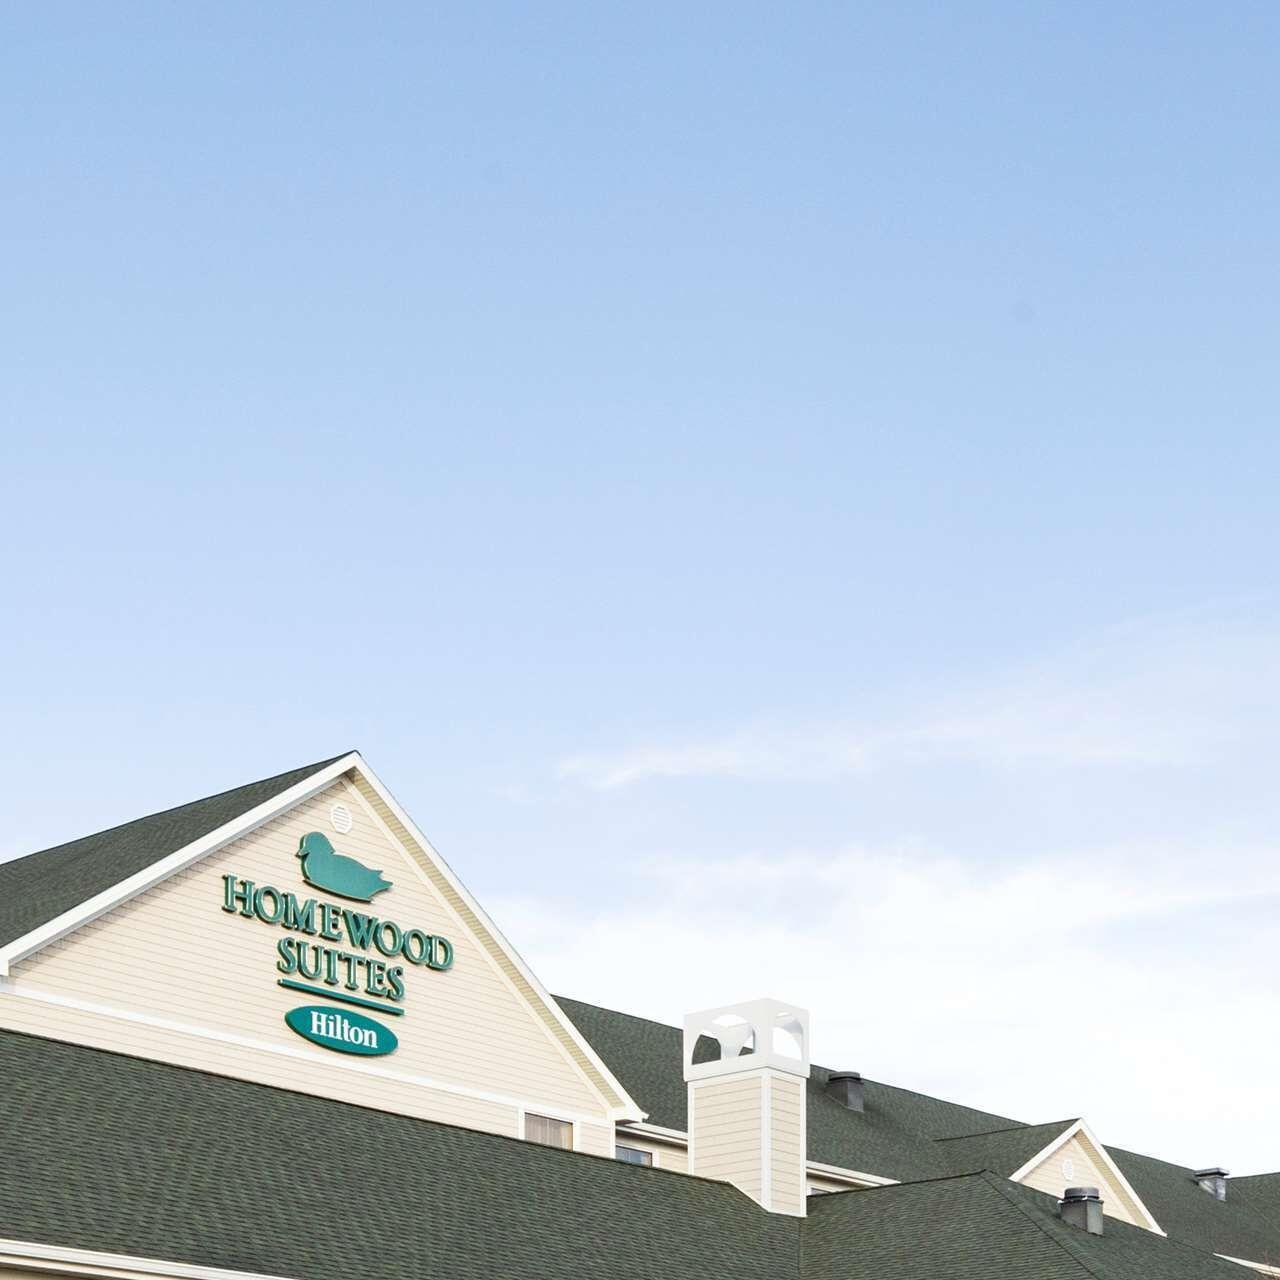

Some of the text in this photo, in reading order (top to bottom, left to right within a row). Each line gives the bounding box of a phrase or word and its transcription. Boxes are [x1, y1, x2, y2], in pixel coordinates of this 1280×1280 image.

[222, 875, 453, 970] HOMEWOOD
[276, 936, 404, 1001] SUITES
[310, 1010, 378, 1049] Hilton
